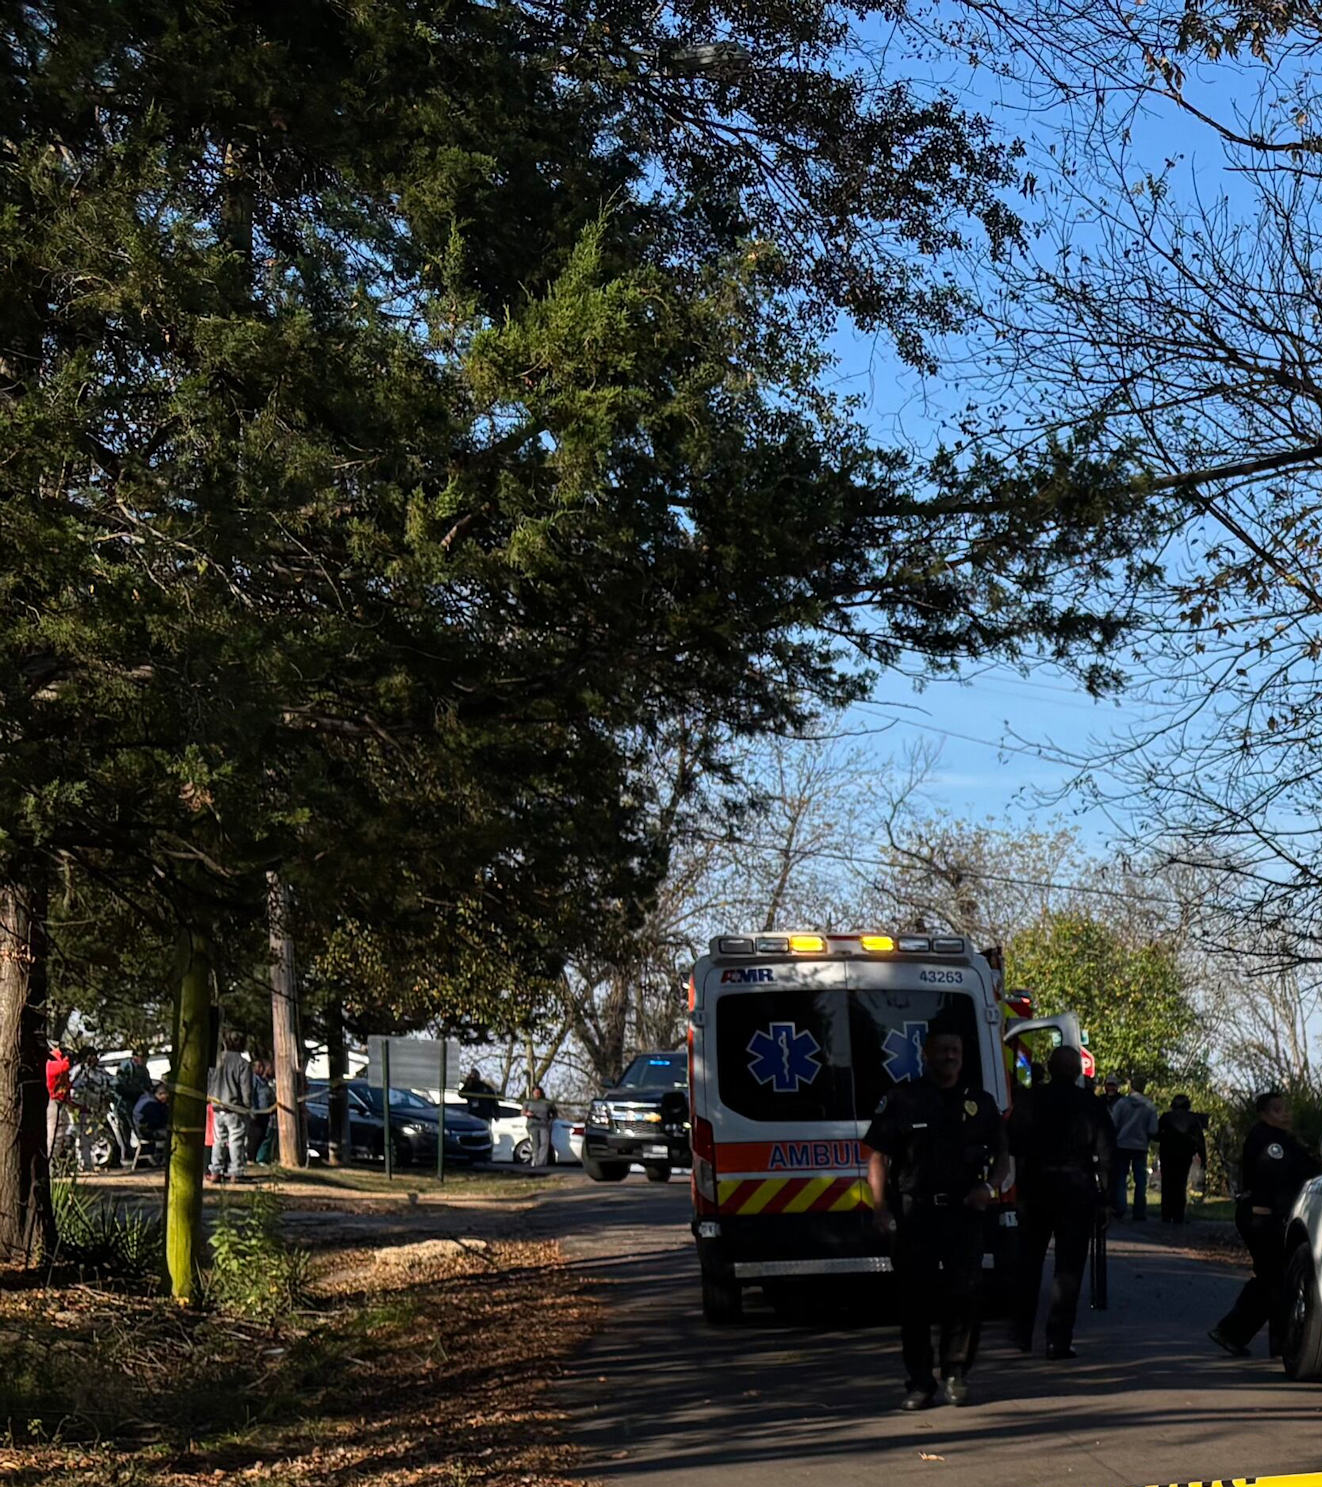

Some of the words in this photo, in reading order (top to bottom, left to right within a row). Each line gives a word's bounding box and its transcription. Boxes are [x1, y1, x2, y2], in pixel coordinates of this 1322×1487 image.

[721, 968, 774, 983] AMR
[919, 970, 963, 984] 43263
[769, 1142, 869, 1169] AMBUL
